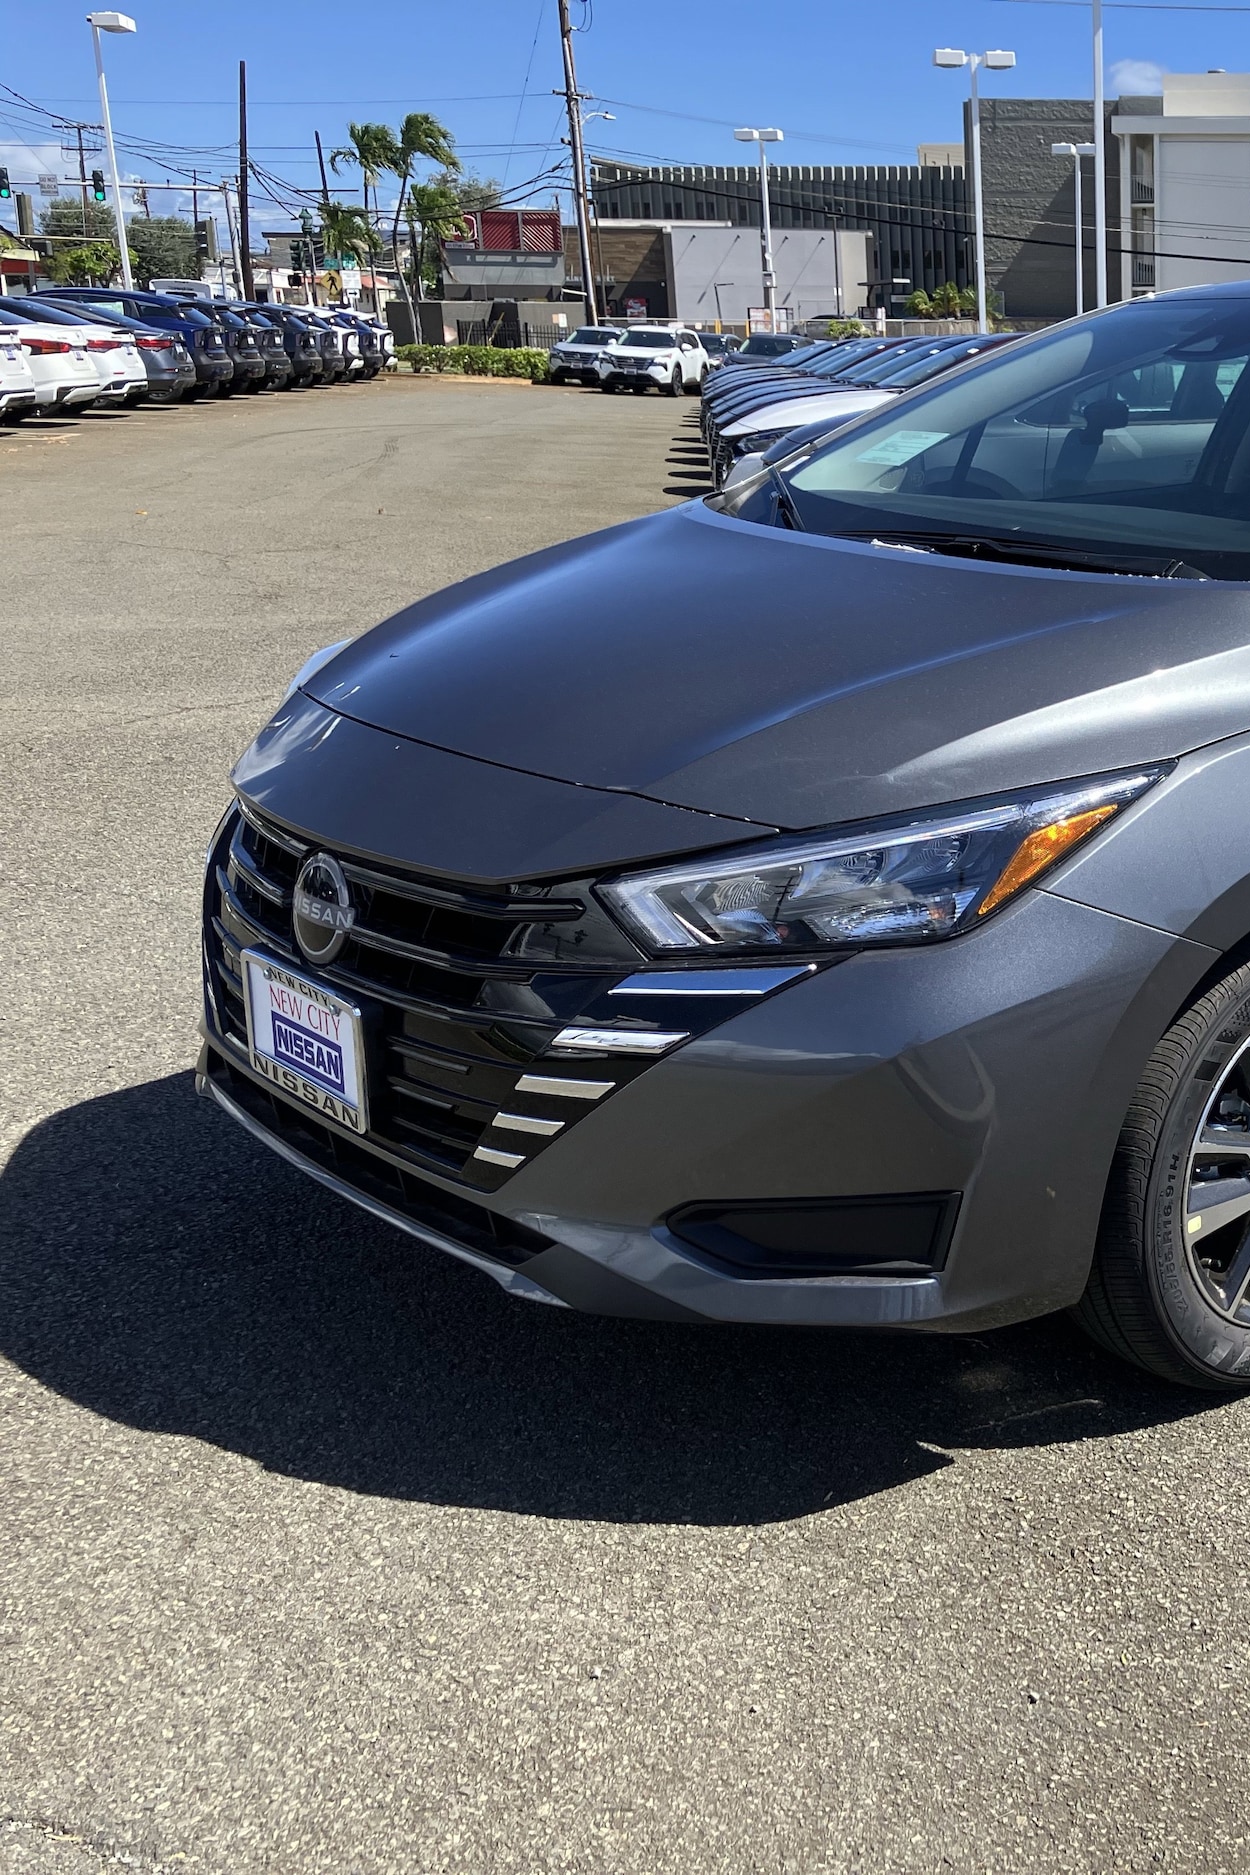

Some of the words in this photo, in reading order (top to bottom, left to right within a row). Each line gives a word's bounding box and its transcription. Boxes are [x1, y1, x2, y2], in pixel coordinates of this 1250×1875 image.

[294, 894, 353, 930] NISSAN
[269, 966, 297, 990] NEW
[299, 980, 330, 1007] CITY
[269, 984, 303, 1021] NEW
[307, 1004, 341, 1041] CITY
[277, 1024, 341, 1081] NISSAN
[254, 1051, 360, 1131] NISSAN
